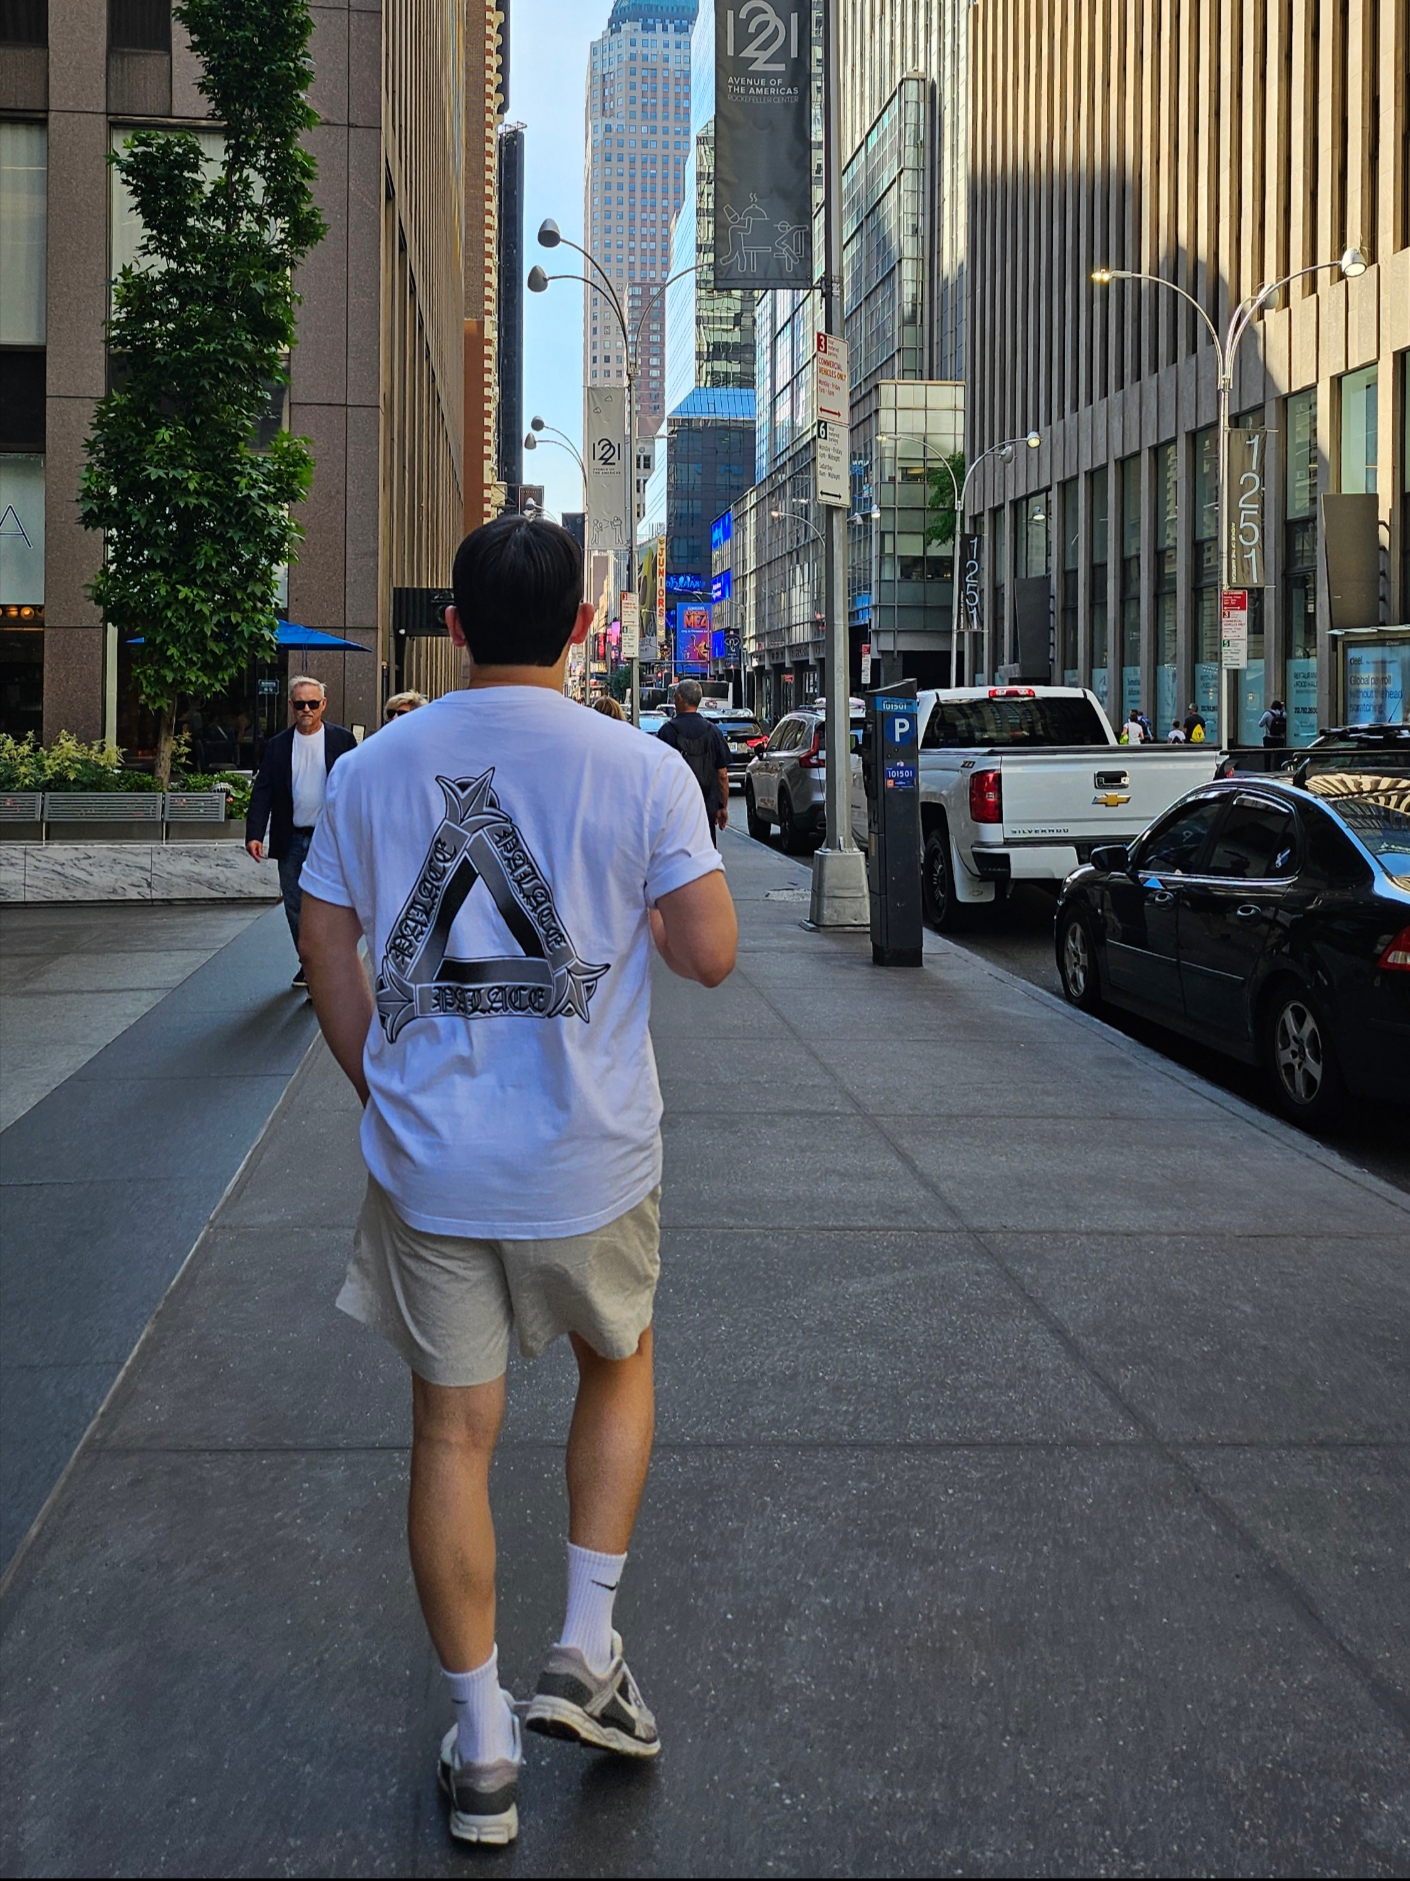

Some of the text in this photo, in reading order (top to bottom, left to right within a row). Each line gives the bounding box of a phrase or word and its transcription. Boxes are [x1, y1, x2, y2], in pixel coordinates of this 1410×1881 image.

[727, 0, 798, 71] 1221
[728, 76, 766, 86] AVENUE
[728, 85, 799, 95] THE AMERICAS
[728, 94, 799, 104] ROCKEFELLER CENTER
[819, 335, 826, 352] 3
[819, 357, 843, 372] COMMERCIAL
[819, 367, 847, 381] VEHICLES ONLY
[819, 421, 826, 439] 6
[593, 438, 620, 465] 1221
[1238, 434, 1261, 583] 1251
[657, 548, 665, 617] JUNIORS
[965, 536, 979, 630] 1251
[1349, 675, 1392, 688] Global payroll
[894, 718, 910, 742] P
[388, 837, 457, 966] PALACE
[494, 827, 568, 953] PALACE
[431, 985, 546, 1014] PALACE
